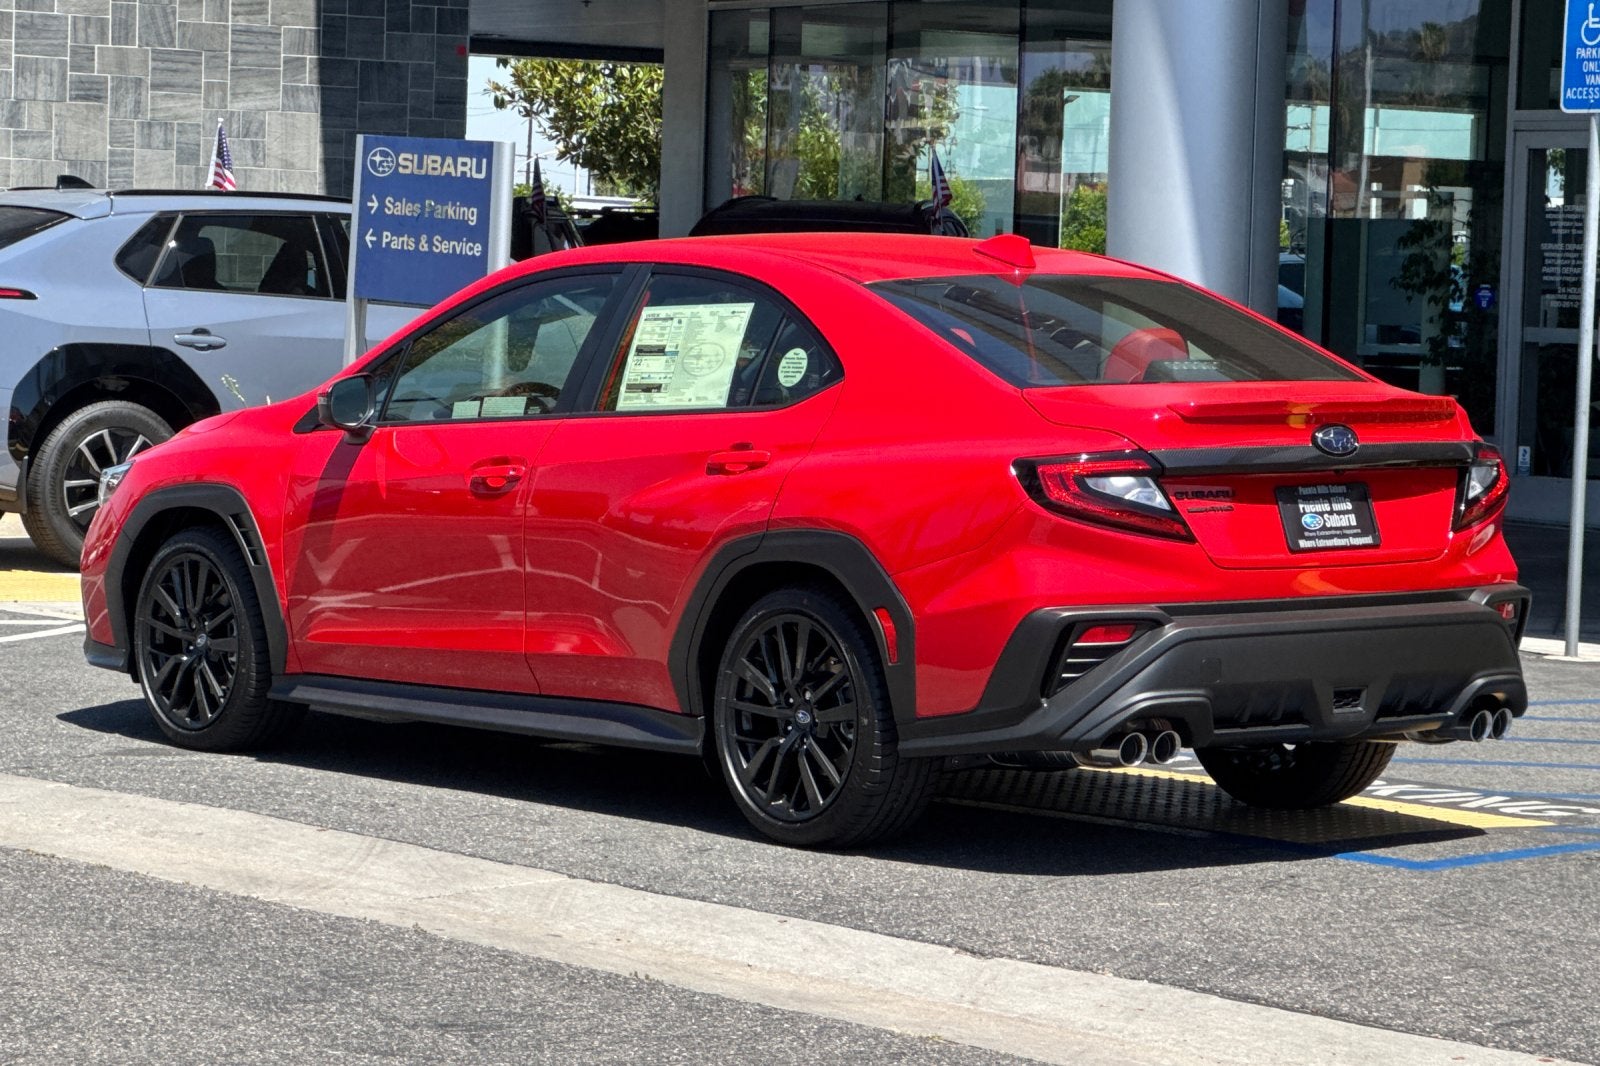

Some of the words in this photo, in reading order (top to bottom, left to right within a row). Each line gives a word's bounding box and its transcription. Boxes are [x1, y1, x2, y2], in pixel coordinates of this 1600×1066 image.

[1582, 60, 1600, 73] ONL
[398, 153, 487, 180] SUBARU
[384, 196, 421, 217] Sales
[424, 199, 478, 226] Parking
[382, 231, 416, 251] Parts
[418, 234, 429, 252] &
[432, 235, 482, 257] Service
[1298, 498, 1331, 513] Puente
[1330, 496, 1353, 511] Hills
[1323, 513, 1357, 527] Subaru
